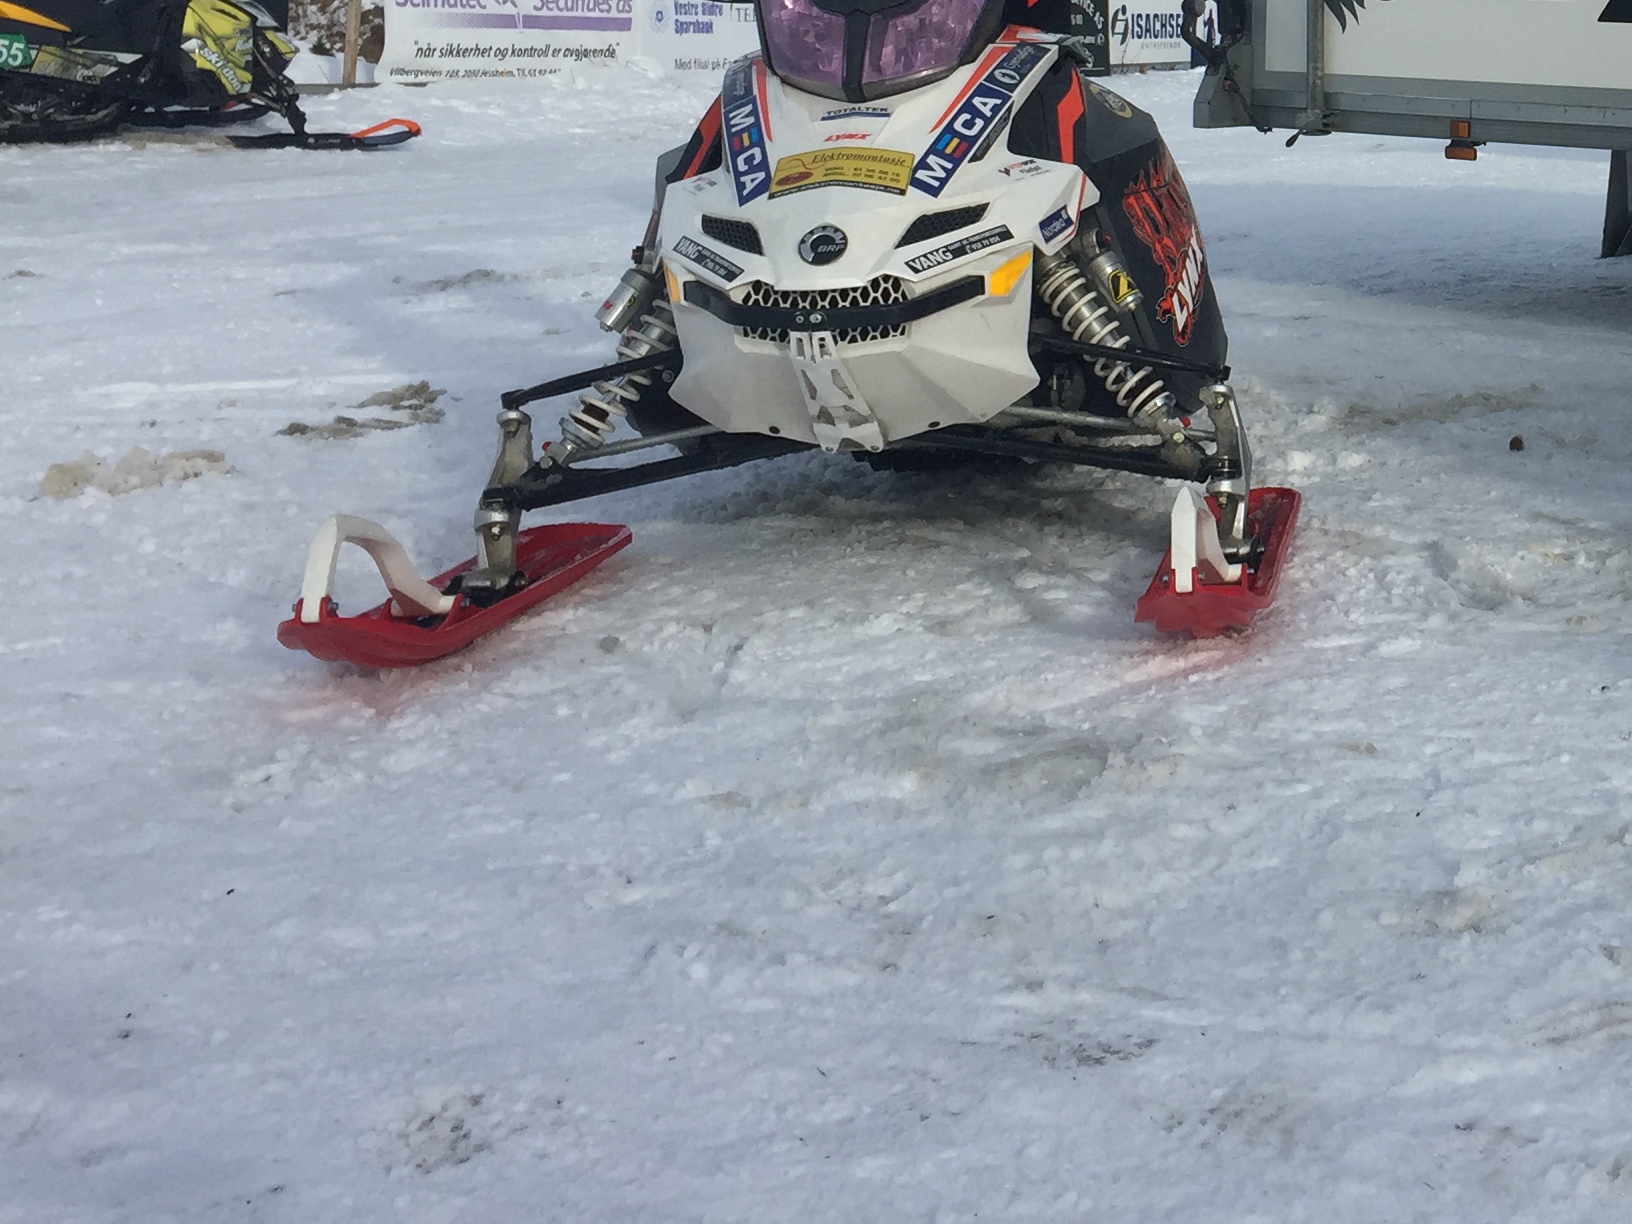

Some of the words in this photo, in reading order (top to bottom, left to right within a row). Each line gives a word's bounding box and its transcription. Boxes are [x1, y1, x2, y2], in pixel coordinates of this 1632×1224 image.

[1131, 13, 1183, 39] ISACHSE
[438, 43, 493, 59] sikkerhet
[494, 46, 509, 61] og
[510, 44, 551, 59] kontroll
[551, 47, 562, 58] er
[908, 247, 954, 273] VANG
